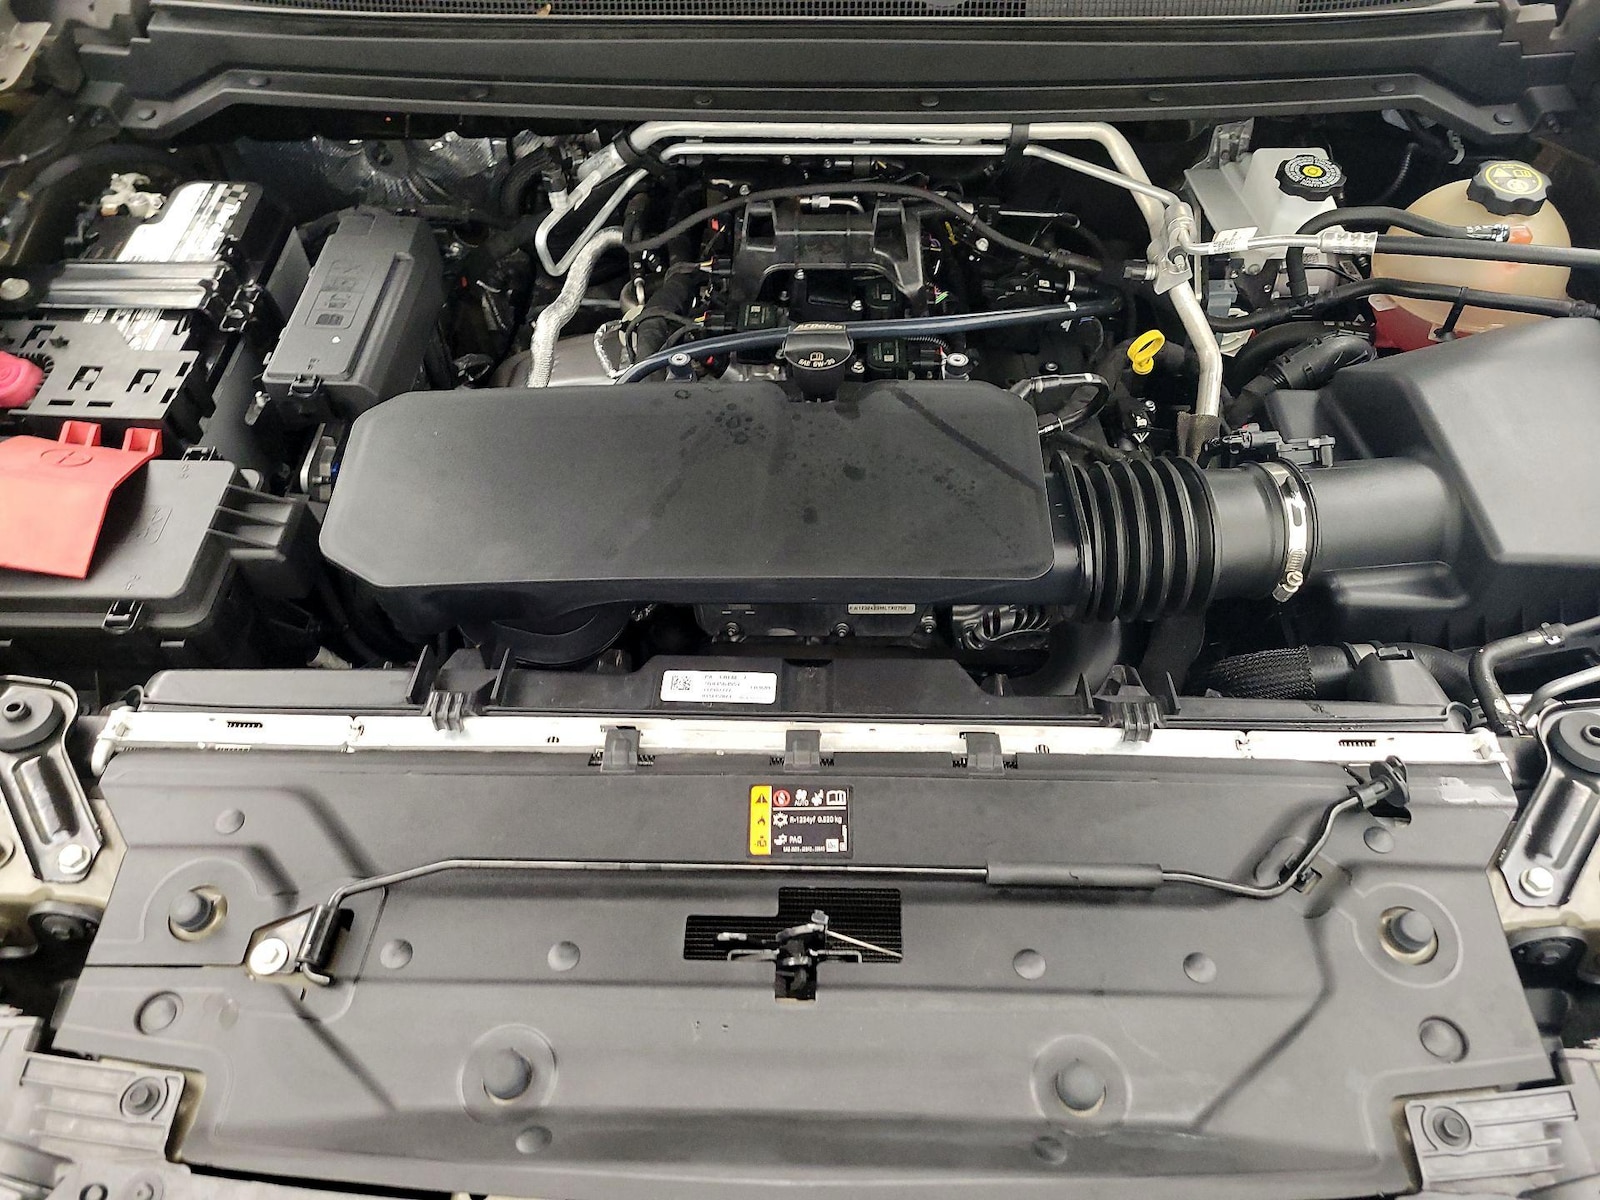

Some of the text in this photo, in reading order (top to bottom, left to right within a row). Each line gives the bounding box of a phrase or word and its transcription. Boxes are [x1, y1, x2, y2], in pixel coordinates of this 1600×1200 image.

[792, 323, 843, 332] ACDelco
[834, 815, 842, 824] kg
[789, 836, 802, 844] PAG
